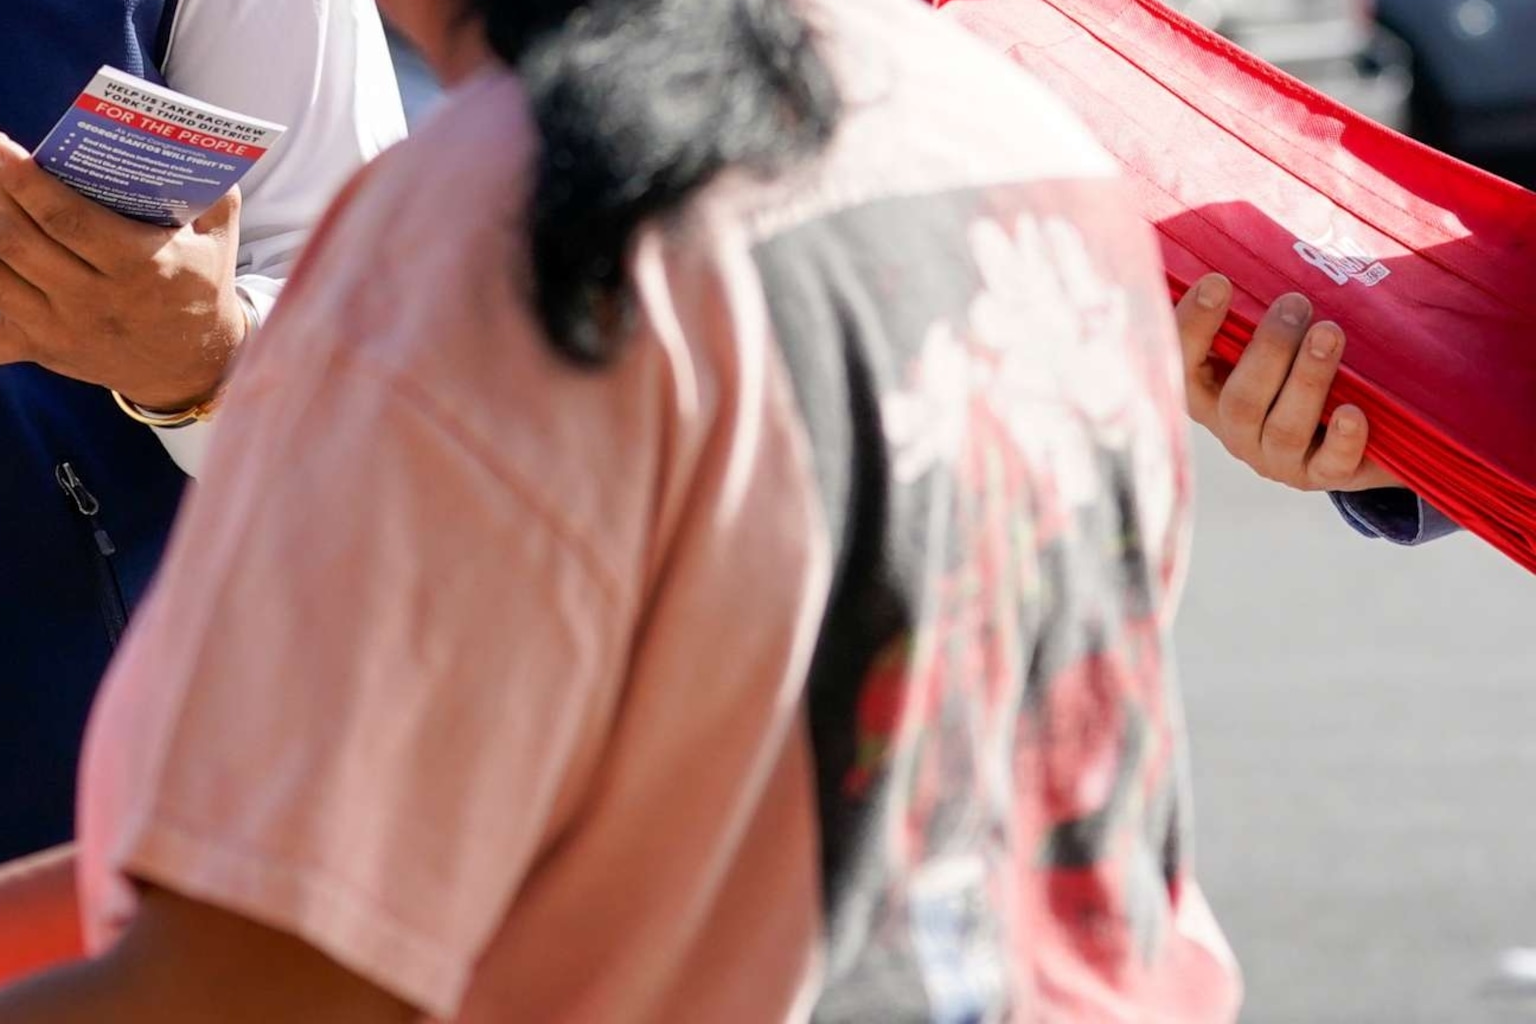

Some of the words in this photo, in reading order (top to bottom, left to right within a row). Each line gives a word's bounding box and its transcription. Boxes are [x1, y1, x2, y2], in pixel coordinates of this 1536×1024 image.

[95, 102, 135, 124] FOR
[140, 117, 176, 137] THE
[177, 129, 248, 156] PEOPLE
[107, 82, 139, 97] HELP
[140, 95, 157, 105] US
[161, 100, 194, 116] TAKE
[196, 113, 233, 128] BACK
[235, 124, 266, 136] NEW
[157, 107, 196, 126] THIRD
[198, 123, 260, 143] DISTRICT
[77, 121, 119, 141] GEORGE
[119, 135, 162, 155] SANTOS
[161, 148, 186, 161] WILL
